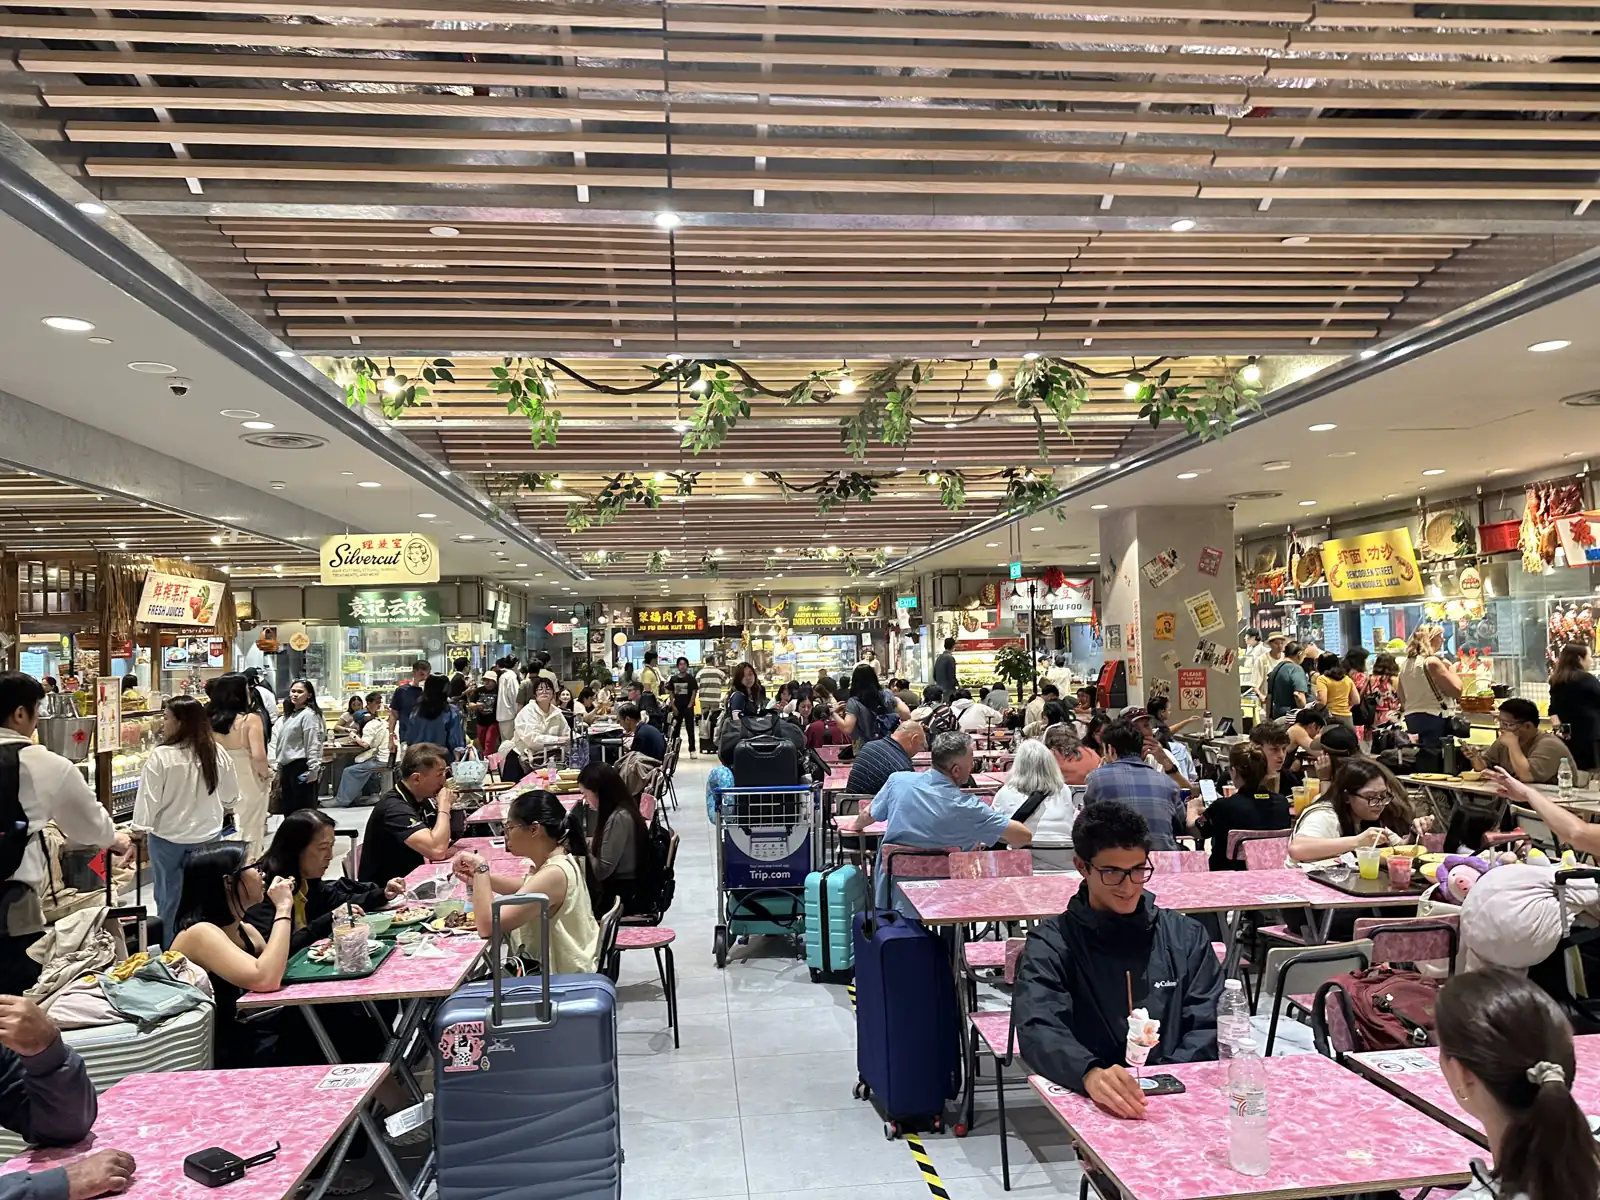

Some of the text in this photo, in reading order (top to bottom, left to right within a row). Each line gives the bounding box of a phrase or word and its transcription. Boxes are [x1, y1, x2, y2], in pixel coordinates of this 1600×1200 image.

[329, 543, 402, 568] Silvercut
[1374, 566, 1393, 576] STREET
[148, 604, 185, 617] FRESH JUICES
[348, 596, 430, 618] 袁记云饺
[816, 617, 841, 625] CUISINE
[749, 870, 791, 881] Trip.com
